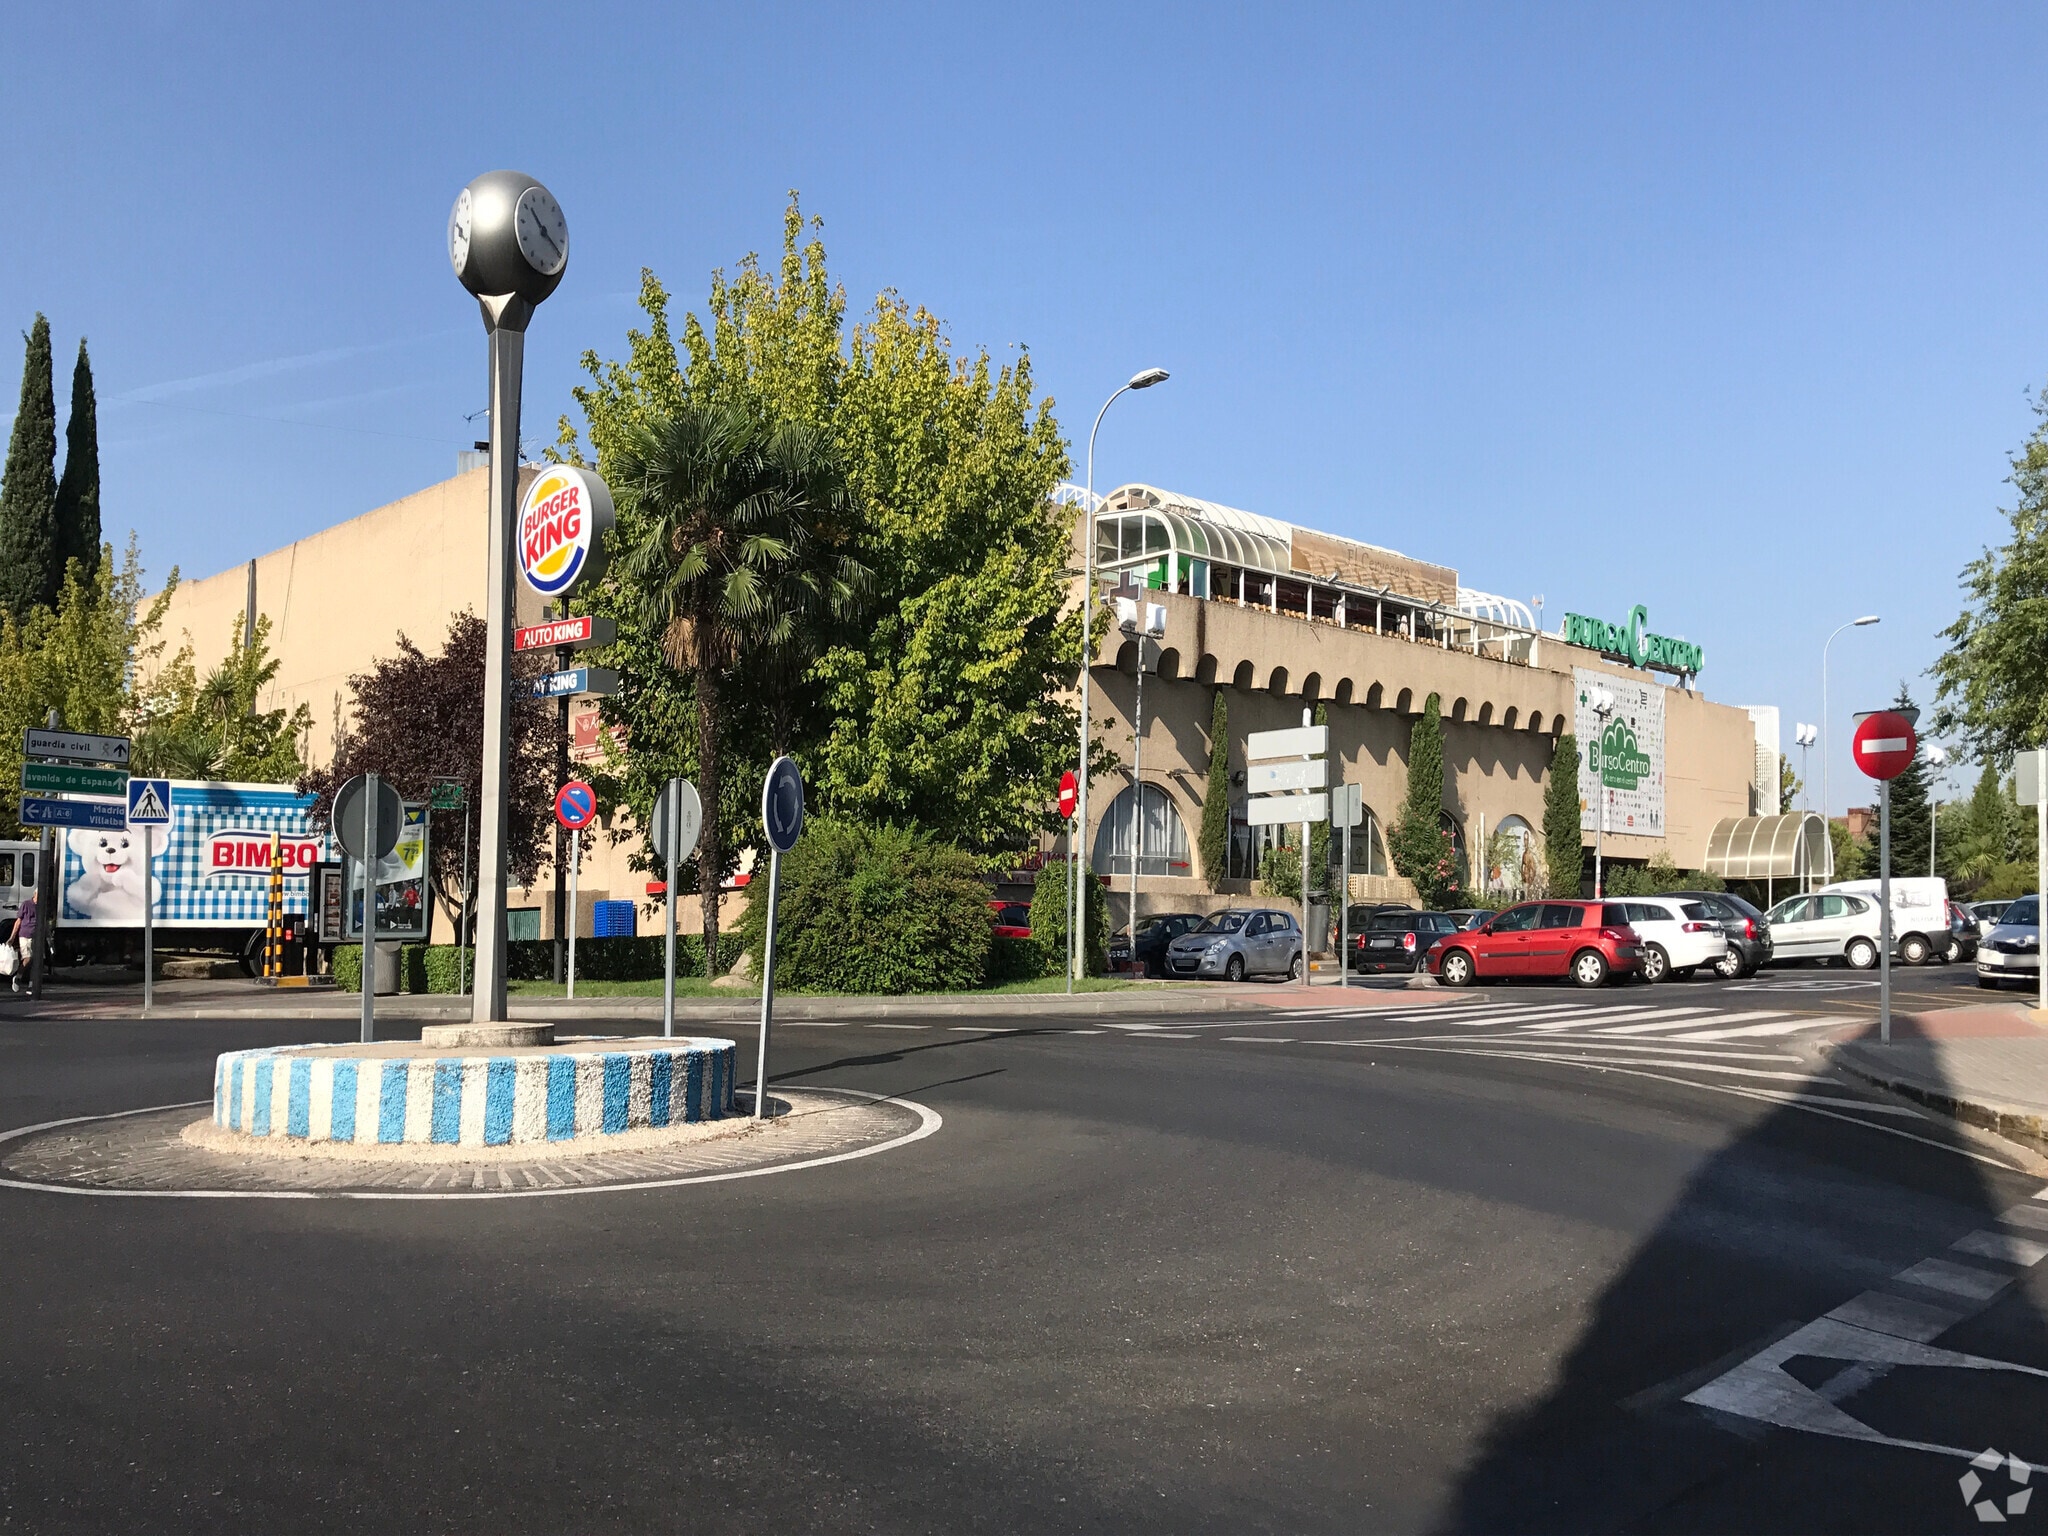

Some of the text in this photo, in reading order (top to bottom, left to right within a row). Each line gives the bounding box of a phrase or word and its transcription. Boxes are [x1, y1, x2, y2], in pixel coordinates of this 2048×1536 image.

[524, 487, 579, 541] BURGER
[526, 507, 581, 571] KING
[523, 621, 583, 646] AUTO KING
[550, 673, 578, 692] KING
[31, 739, 91, 752] guardia civil
[26, 773, 61, 783] avenida
[65, 776, 76, 784] de
[93, 805, 125, 815] Madrid
[89, 815, 124, 826] Villalba
[212, 842, 318, 868] BIMBO
